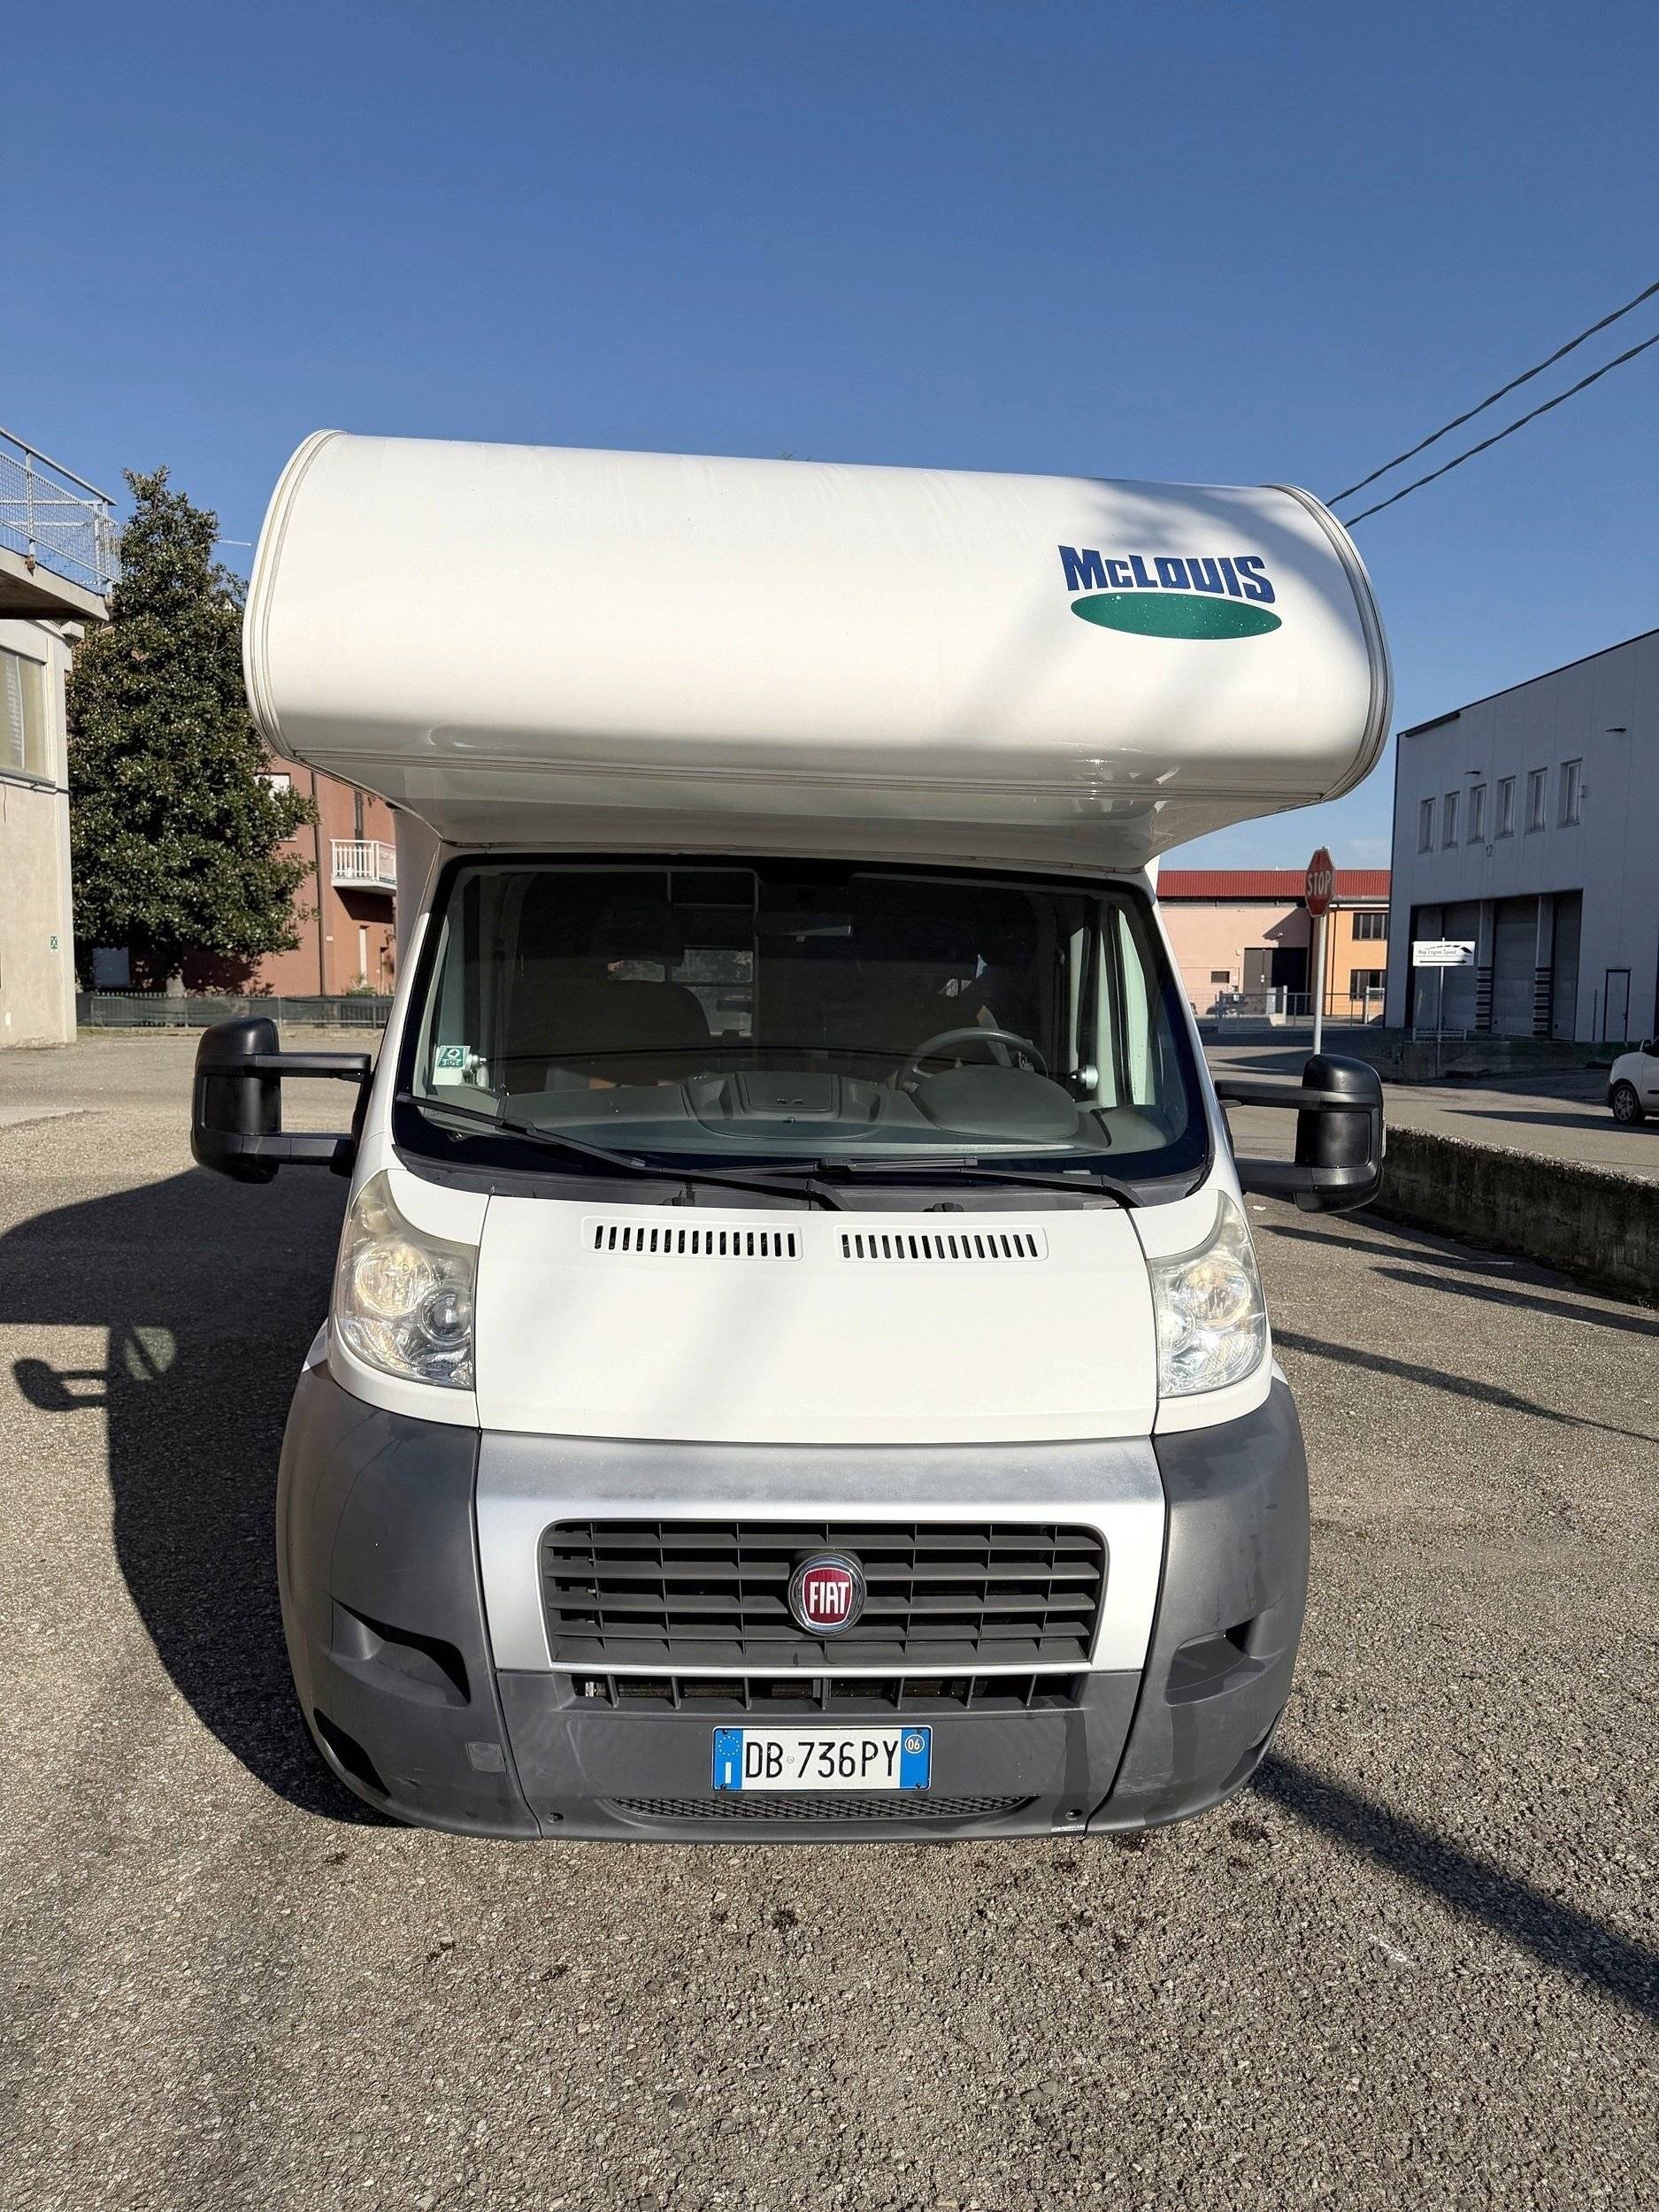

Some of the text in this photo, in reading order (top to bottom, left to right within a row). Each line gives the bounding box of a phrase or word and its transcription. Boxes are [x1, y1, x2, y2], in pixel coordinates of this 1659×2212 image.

[1307, 870, 1332, 896] STOP
[809, 1581, 849, 1615] FIAT
[745, 1740, 899, 1778] DB 736PY
[906, 1737, 921, 1751] 06
